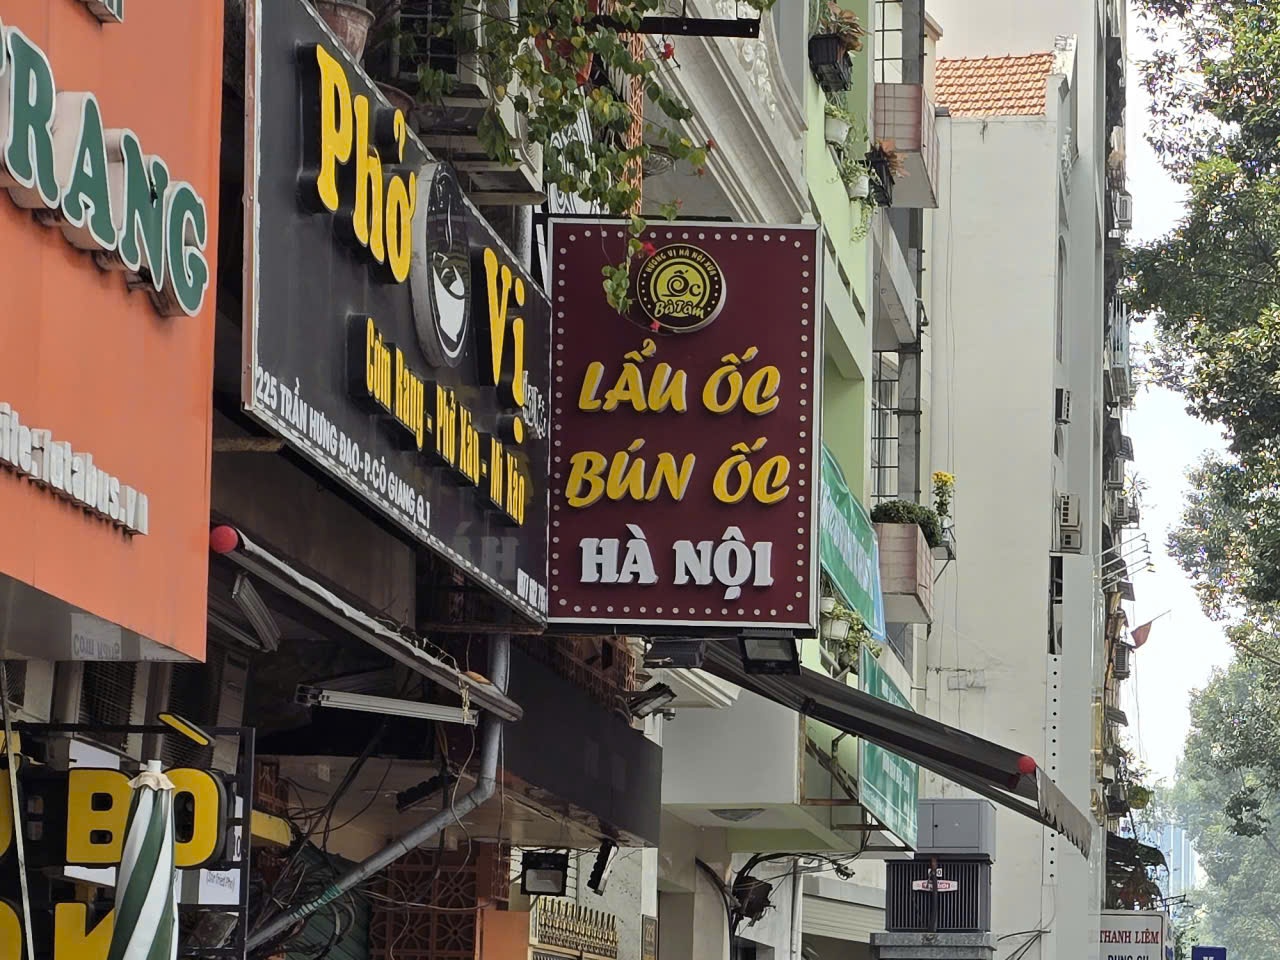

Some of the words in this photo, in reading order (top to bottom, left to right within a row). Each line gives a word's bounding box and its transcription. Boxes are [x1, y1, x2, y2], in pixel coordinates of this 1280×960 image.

[0, 25, 208, 317] RANG
[316, 44, 416, 283] Phở
[484, 247, 525, 444] Vị
[255, 366, 277, 410] 225
[280, 377, 308, 433] TRẦN
[309, 407, 338, 456] HƯNG
[339, 431, 360, 476] ĐẠO
[366, 318, 391, 411] Cơm
[395, 347, 424, 450] Rang
[437, 384, 456, 468] Phở
[459, 401, 480, 487] Xào
[490, 434, 503, 508] Mì
[507, 451, 525, 525] Xào
[702, 345, 782, 415] ỐC
[564, 437, 697, 508] BÚN
[712, 437, 791, 506] ỐC
[579, 523, 659, 585] HÀ
[673, 525, 774, 600] NỘI
[1100, 931, 1131, 944] THANH
[1135, 928, 1160, 944] LIÊM
